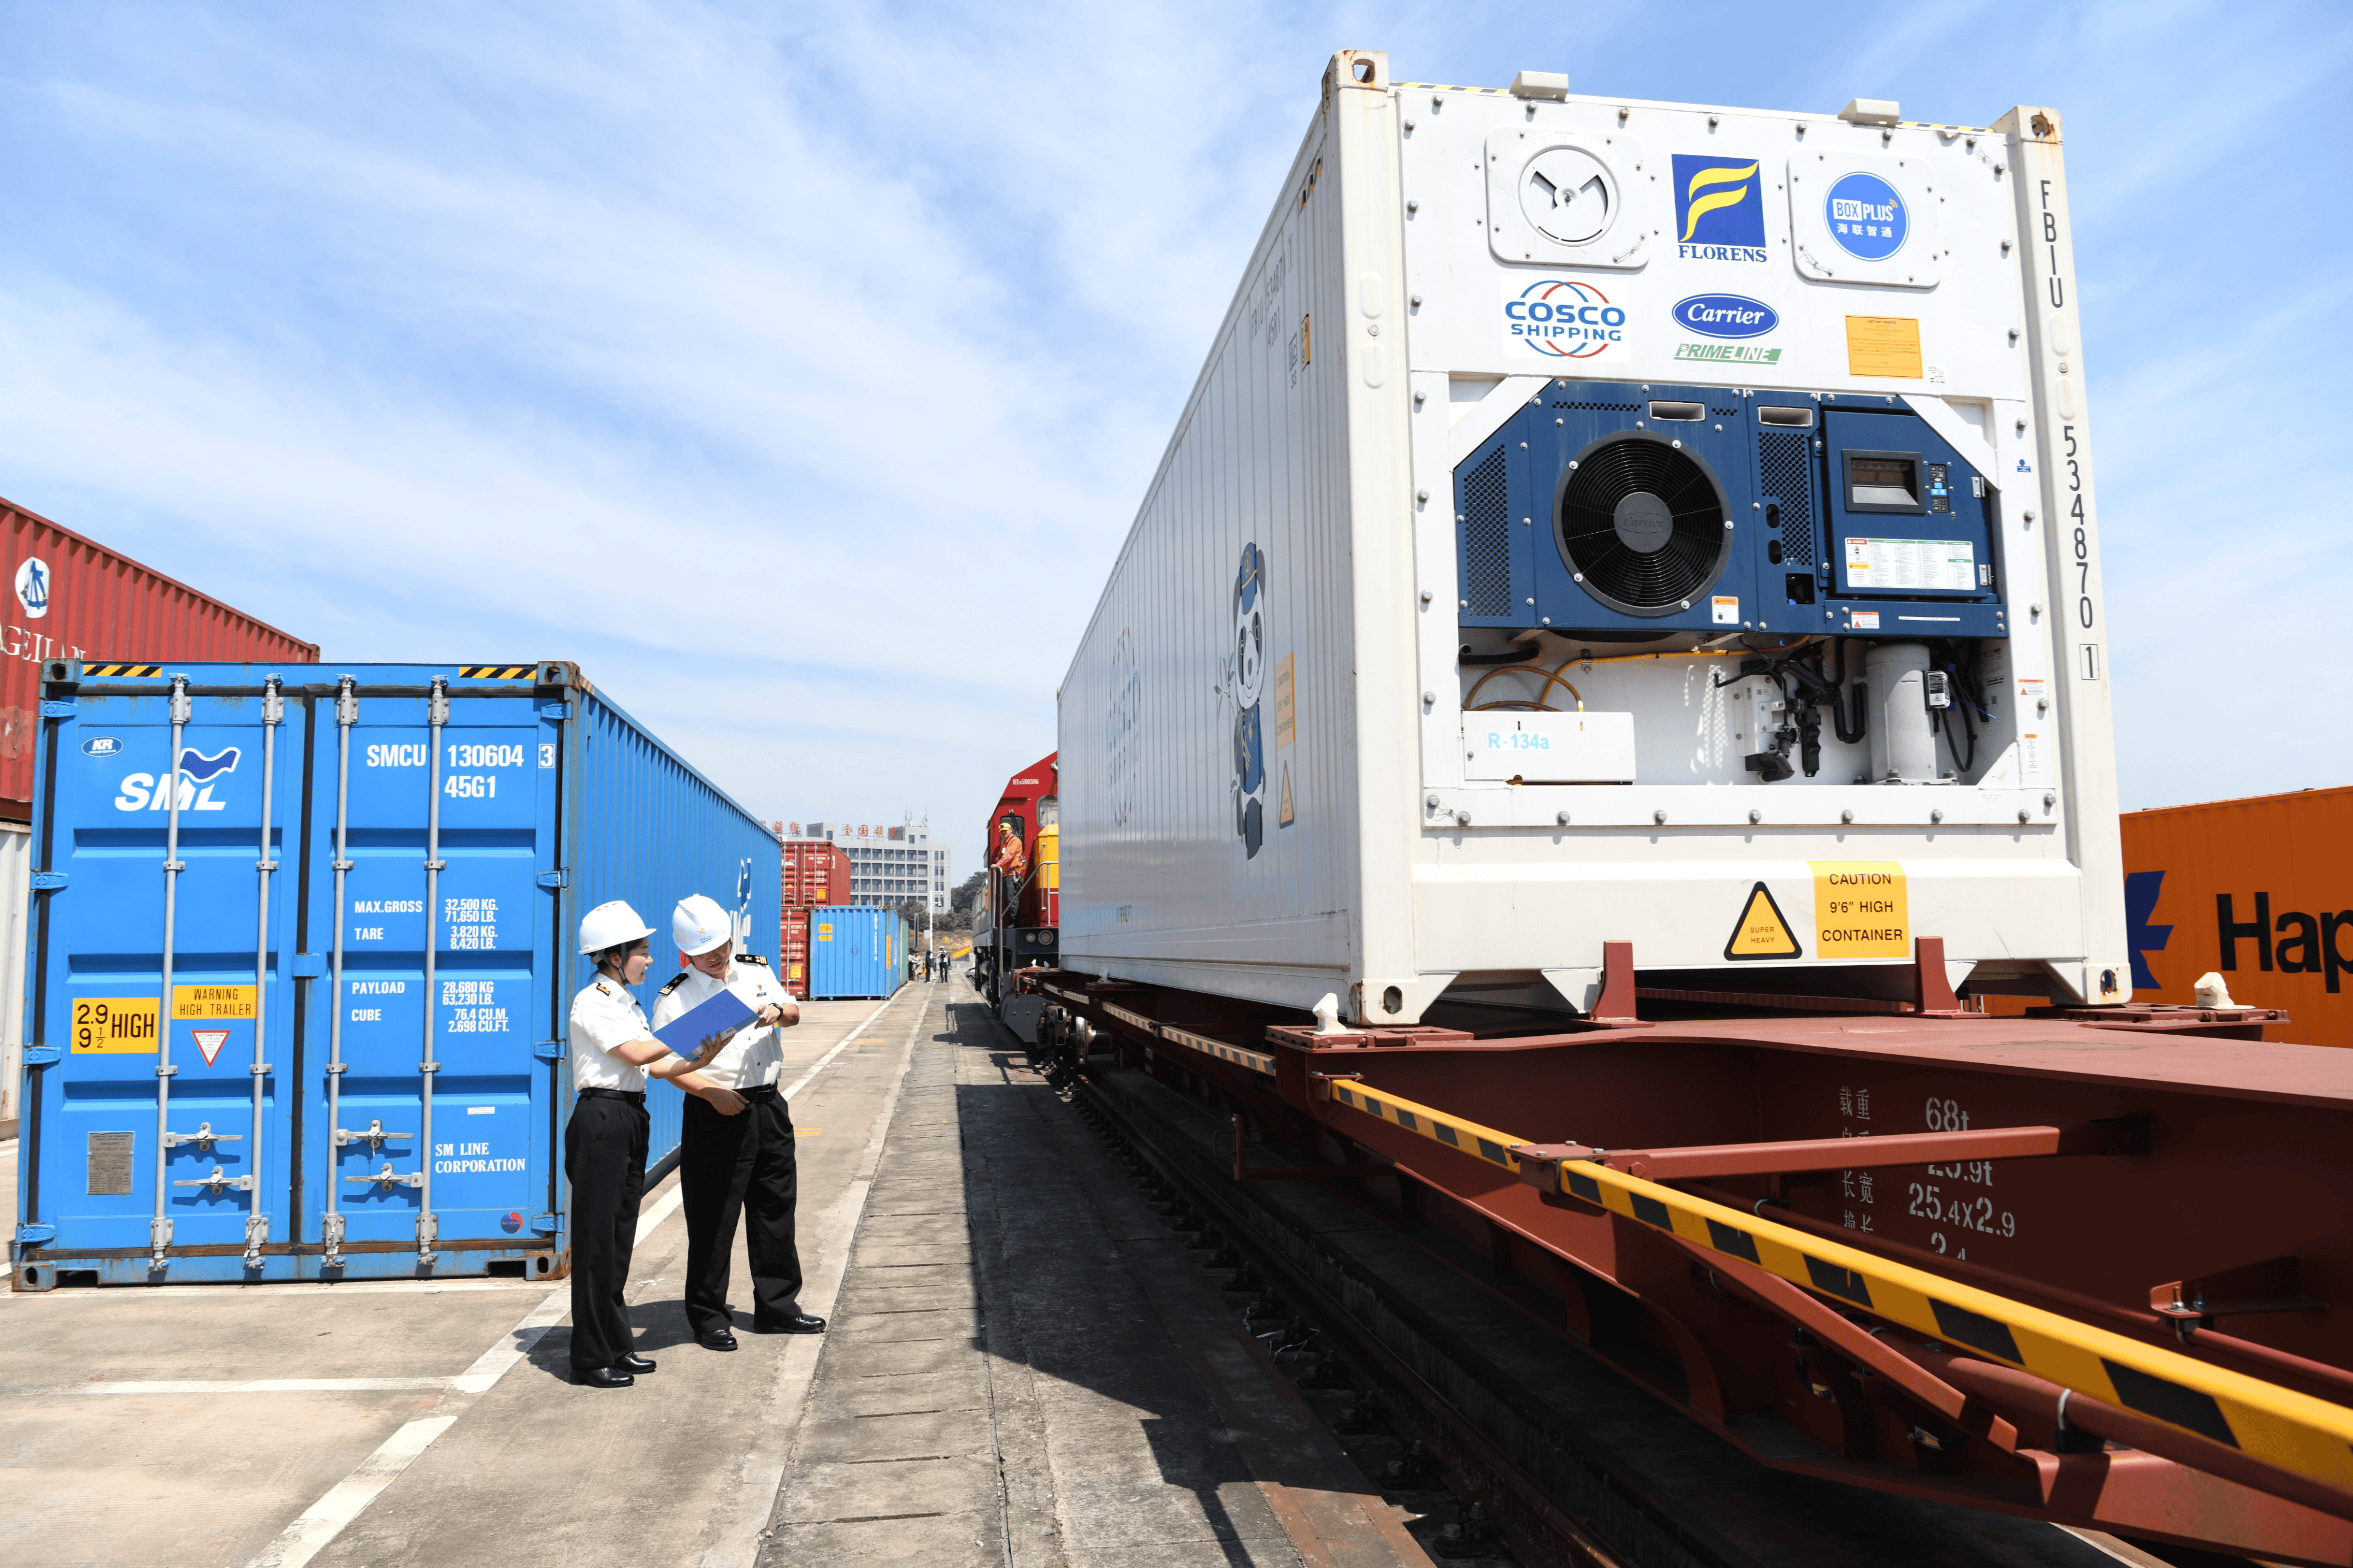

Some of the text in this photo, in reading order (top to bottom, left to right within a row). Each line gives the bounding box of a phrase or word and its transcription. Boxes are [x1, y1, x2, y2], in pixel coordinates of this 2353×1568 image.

[1837, 222, 1893, 238] 海联智通
[1678, 244, 1767, 263] FLORENS
[1504, 301, 1626, 327] COSCO
[1687, 303, 1765, 326] Carrier
[1510, 323, 1622, 342] SHIPPING
[2040, 180, 2063, 308] FBIU
[2063, 425, 2093, 629] 534870
[1624, 516, 1663, 527] Carrier
[92, 739, 113, 750] KR
[367, 744, 554, 767] SMCU 130604 3
[115, 772, 227, 812] SML
[444, 775, 496, 798] 45G1
[1830, 873, 1891, 885] CAUTION
[354, 898, 498, 913] MAX.GROSS 32,500 KG.
[1860, 901, 1893, 912] HIGH
[444, 910, 496, 923] 71,650 LB.
[354, 925, 498, 940] TARE 3,820 KG.
[1822, 929, 1903, 942] CONTAINER
[450, 937, 496, 950] 8,420 LB.
[193, 988, 239, 1001] WARNING
[352, 981, 494, 994] PAYLOAD 28,680 KG
[442, 993, 494, 1006] 63,230 LB.
[77, 1004, 109, 1025] 2.9
[179, 1003, 251, 1016] HIGH TRAILER
[351, 1008, 509, 1022] CUBE 76.4 CU.M.
[111, 1013, 155, 1038] HIGH
[447, 1019, 510, 1032] 2,698 CU.FT.
[1926, 1097, 1970, 1133] 68t
[435, 1143, 490, 1157] SM LINE
[434, 1158, 526, 1173] CORPORATION
[1841, 1170, 1874, 1204] 长宽
